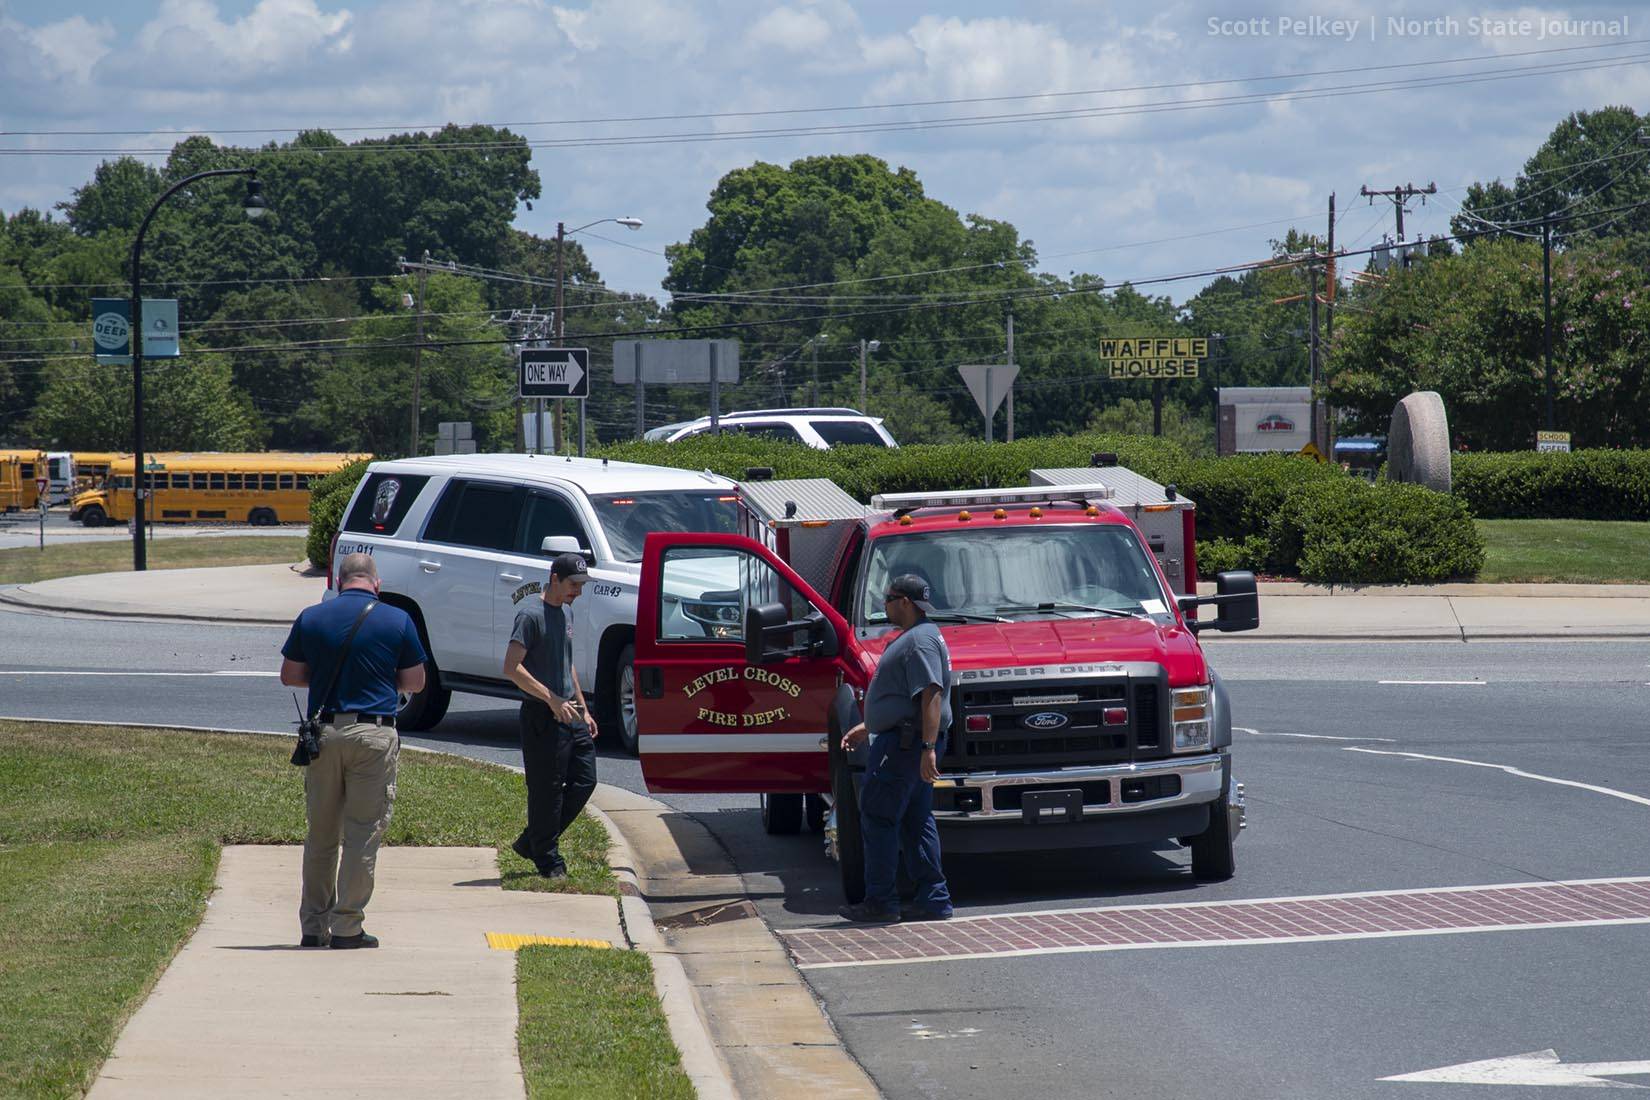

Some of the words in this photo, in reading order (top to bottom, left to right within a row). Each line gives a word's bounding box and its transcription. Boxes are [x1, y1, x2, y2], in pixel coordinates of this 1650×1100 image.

[95, 322, 127, 337] DEEP
[1101, 340, 1206, 357] WAFFLE
[527, 364, 546, 382] ONE
[548, 364, 567, 382] WAY
[1111, 360, 1196, 377] HOUSE
[357, 544, 374, 556] 911
[962, 666, 1045, 680] SUPER
[1059, 664, 1125, 674] DUTY
[683, 667, 739, 698] LEVEL
[743, 666, 801, 697] CROSS
[697, 707, 737, 726] FIRE
[743, 707, 791, 726] DEPT.
